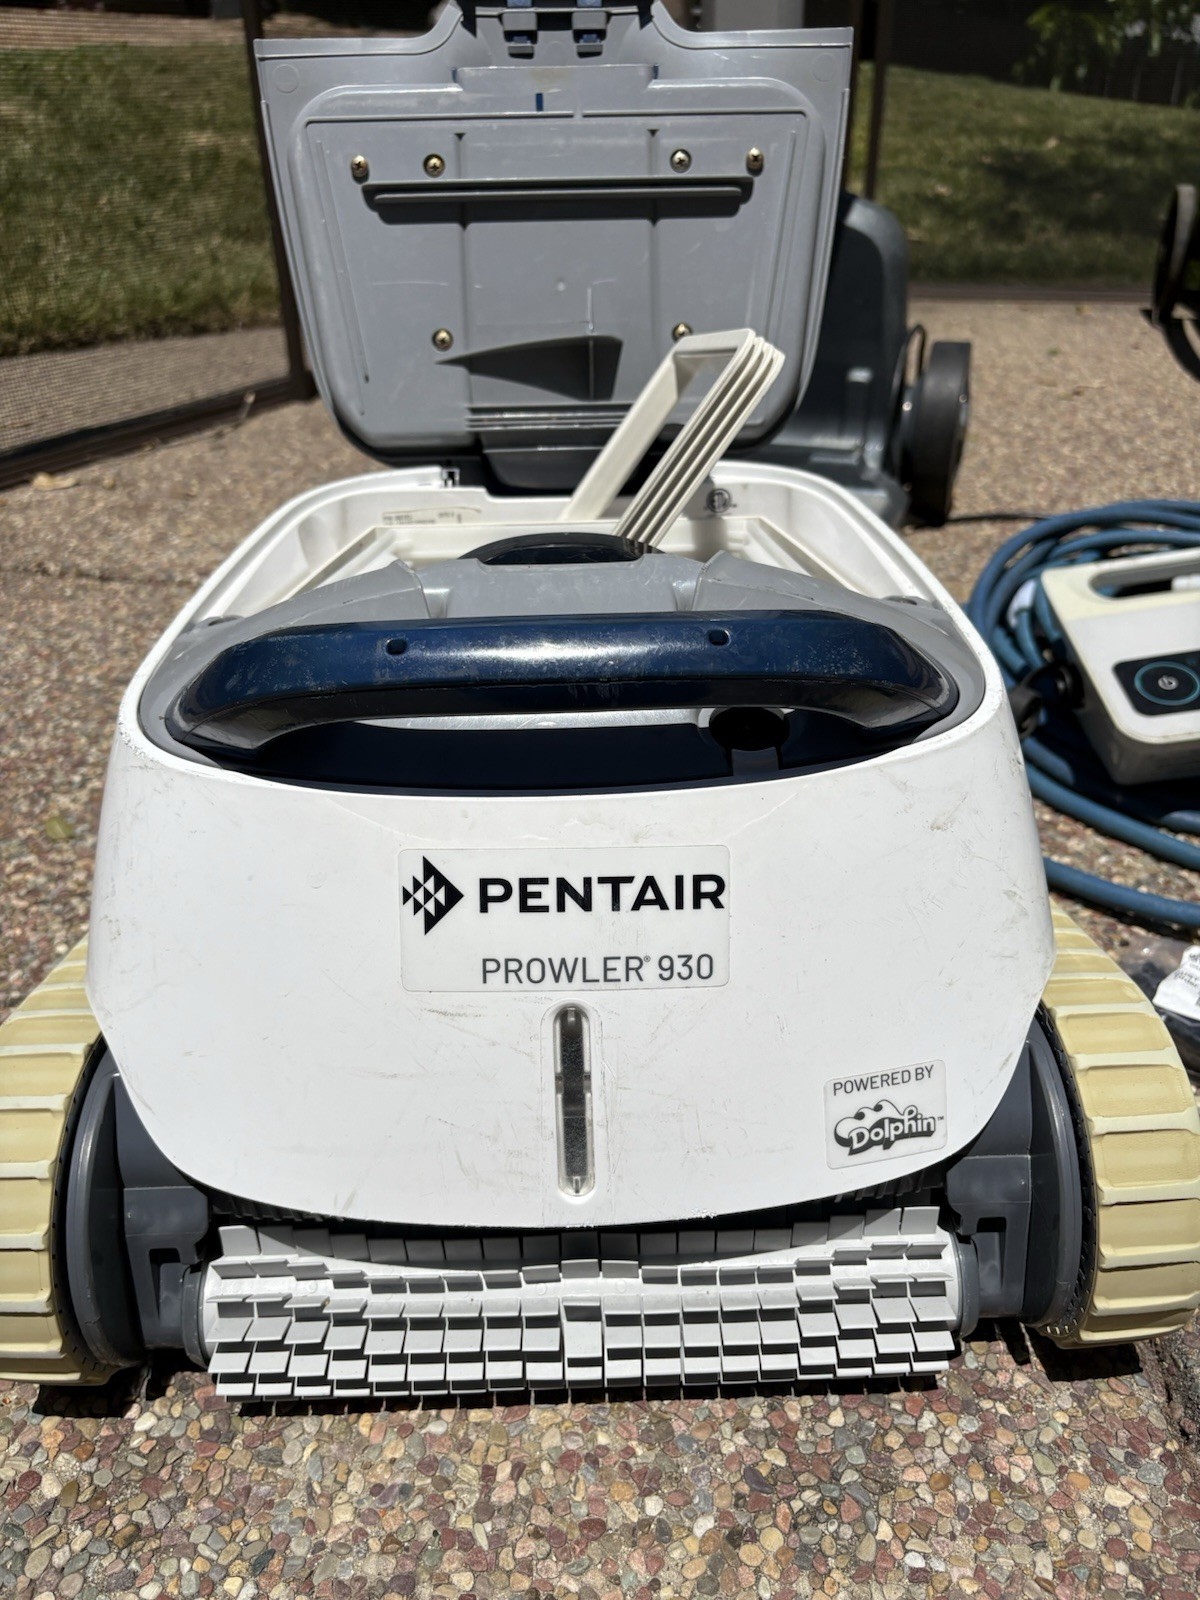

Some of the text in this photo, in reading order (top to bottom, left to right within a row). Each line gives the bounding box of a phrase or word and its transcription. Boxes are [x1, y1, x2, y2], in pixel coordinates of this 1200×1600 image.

[479, 874, 725, 913] PENTAIR
[658, 954, 714, 981] 930
[833, 1064, 934, 1096] POWERED BY
